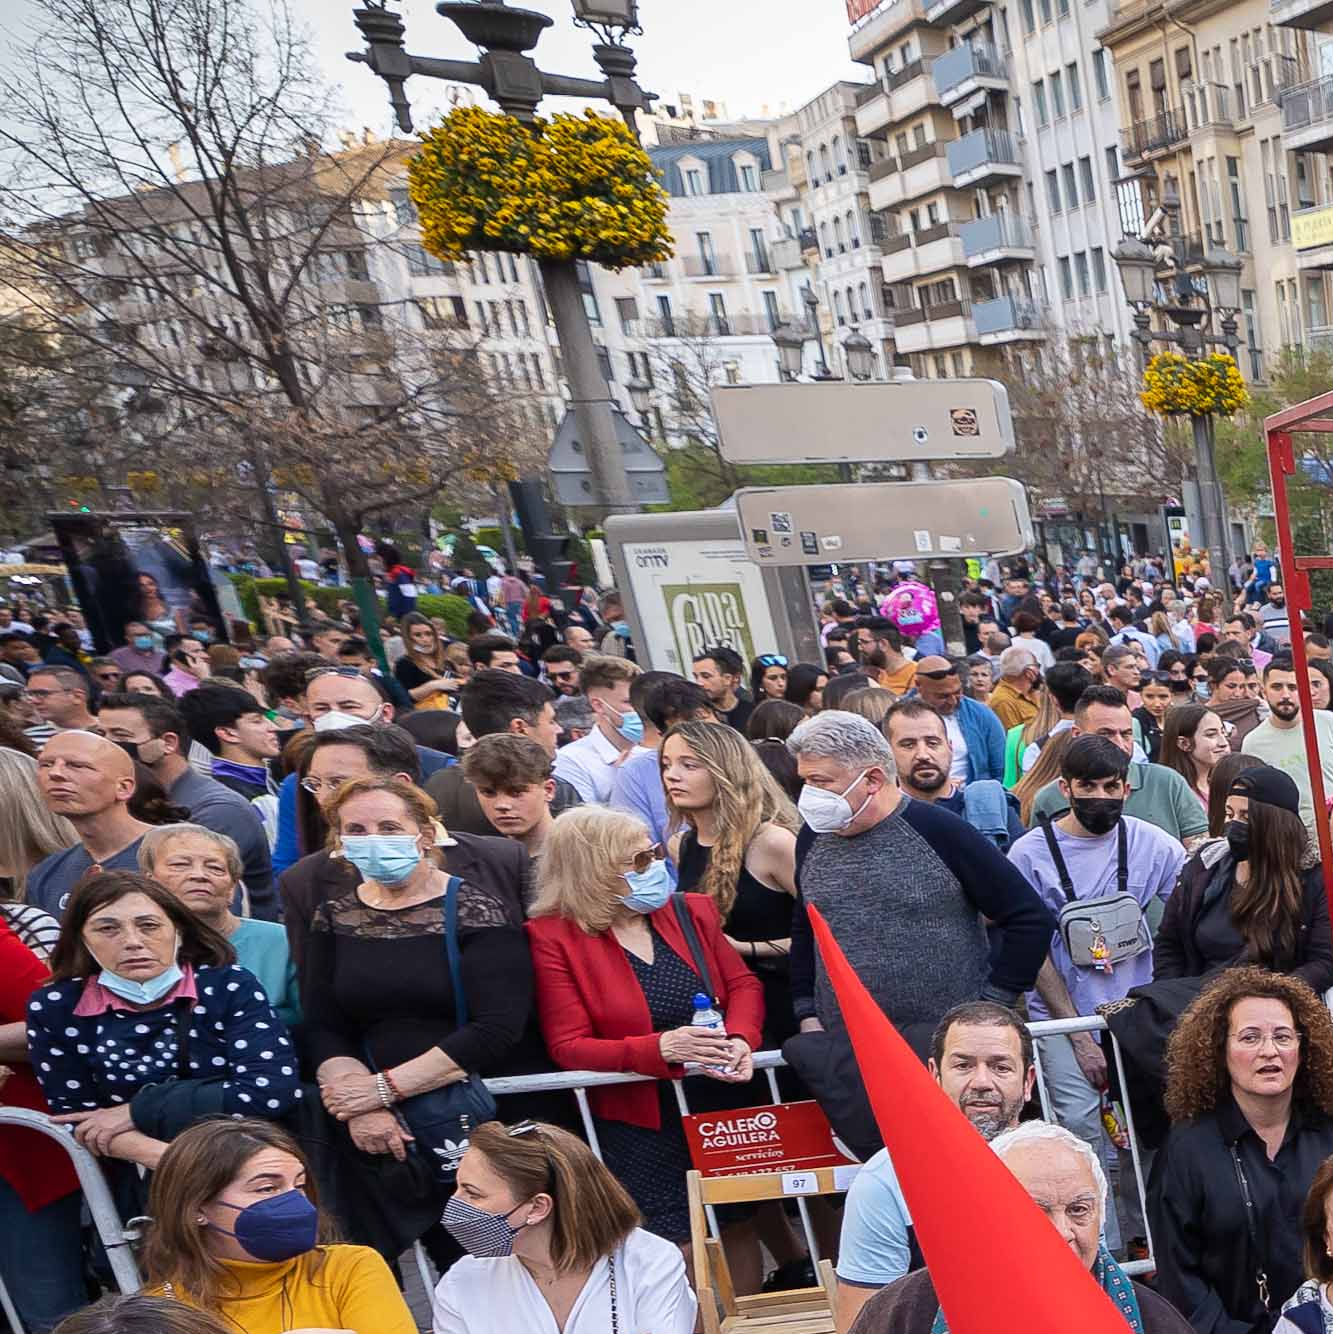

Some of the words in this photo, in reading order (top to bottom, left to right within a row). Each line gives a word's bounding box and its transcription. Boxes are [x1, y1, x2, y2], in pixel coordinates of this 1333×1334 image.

[698, 1112, 777, 1136] CALERO
[702, 1130, 780, 1149] AGUILERA
[735, 1148, 784, 1162] servicios
[793, 1179, 806, 1188] 97
